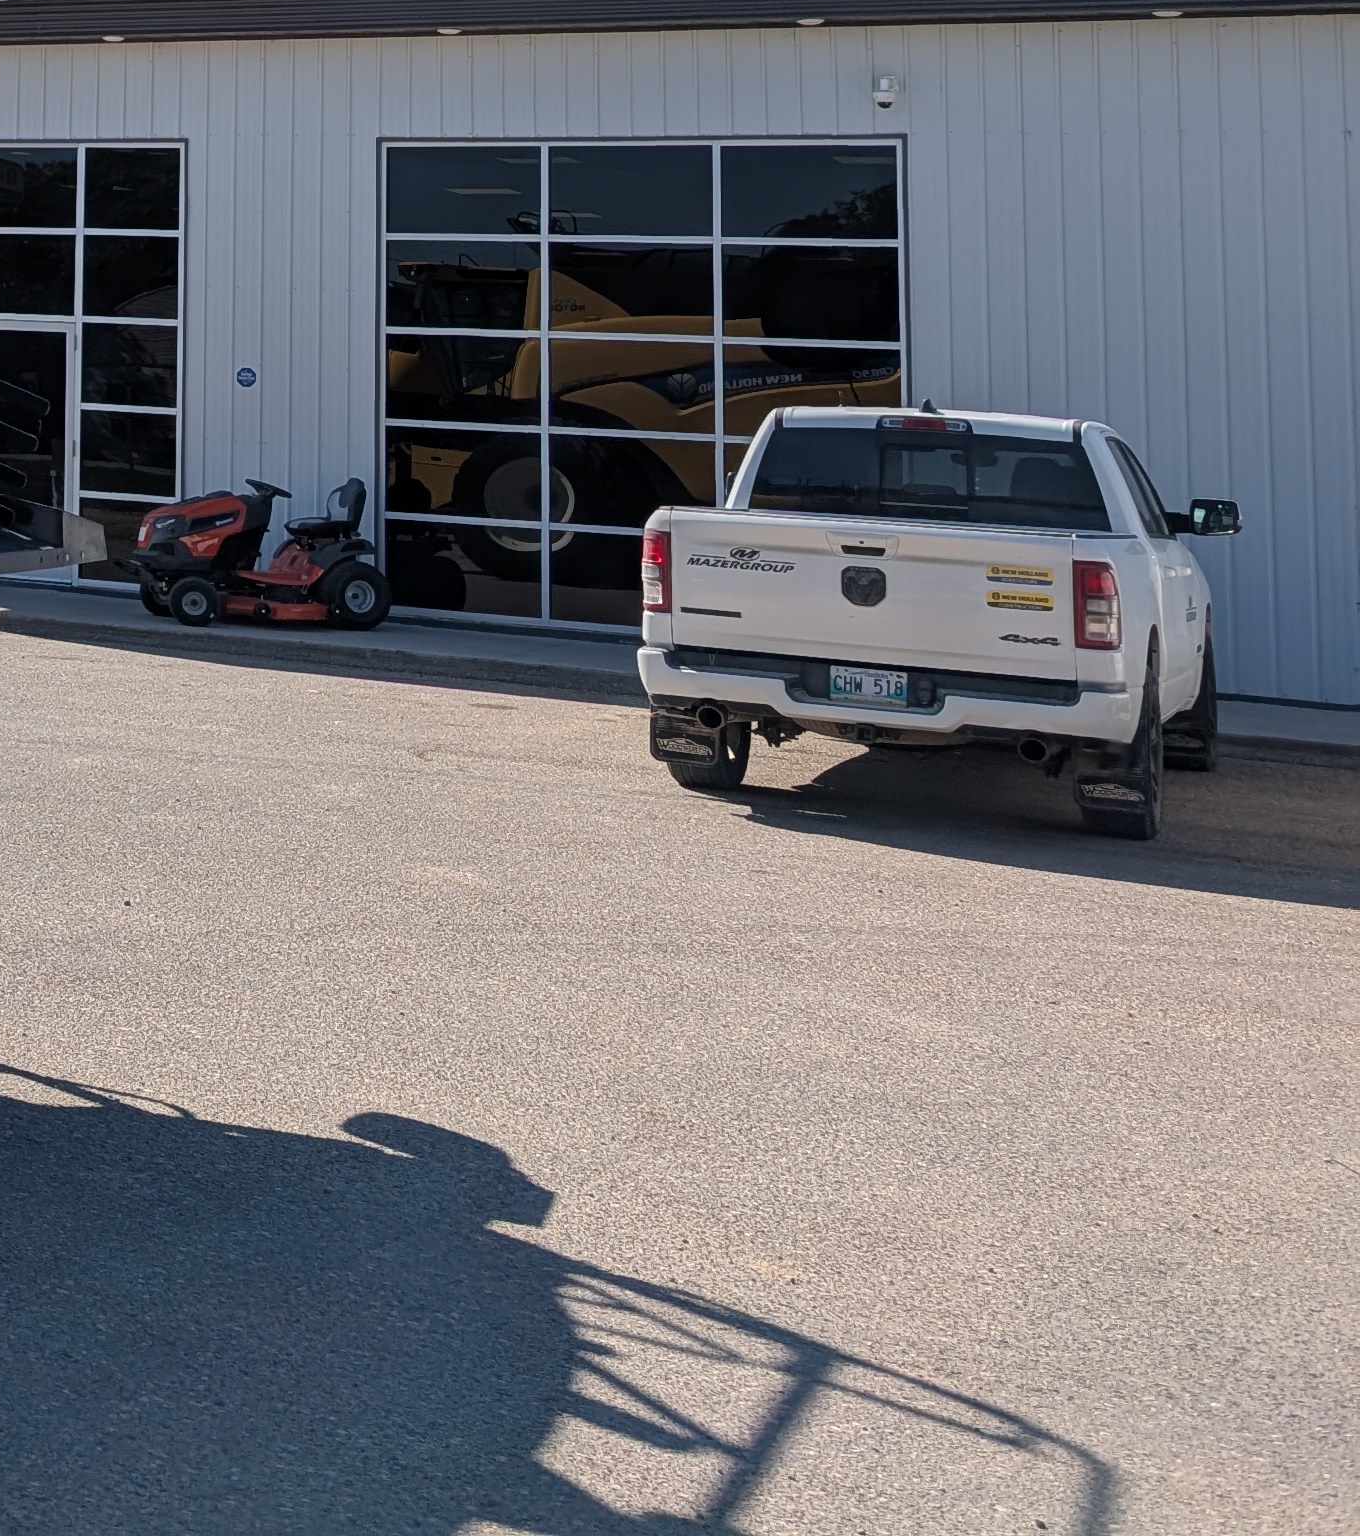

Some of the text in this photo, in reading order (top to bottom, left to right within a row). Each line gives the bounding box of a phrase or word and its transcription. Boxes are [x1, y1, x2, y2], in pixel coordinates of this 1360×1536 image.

[686, 557, 795, 573] MAZERGROUP
[833, 674, 904, 697] CHW 518
